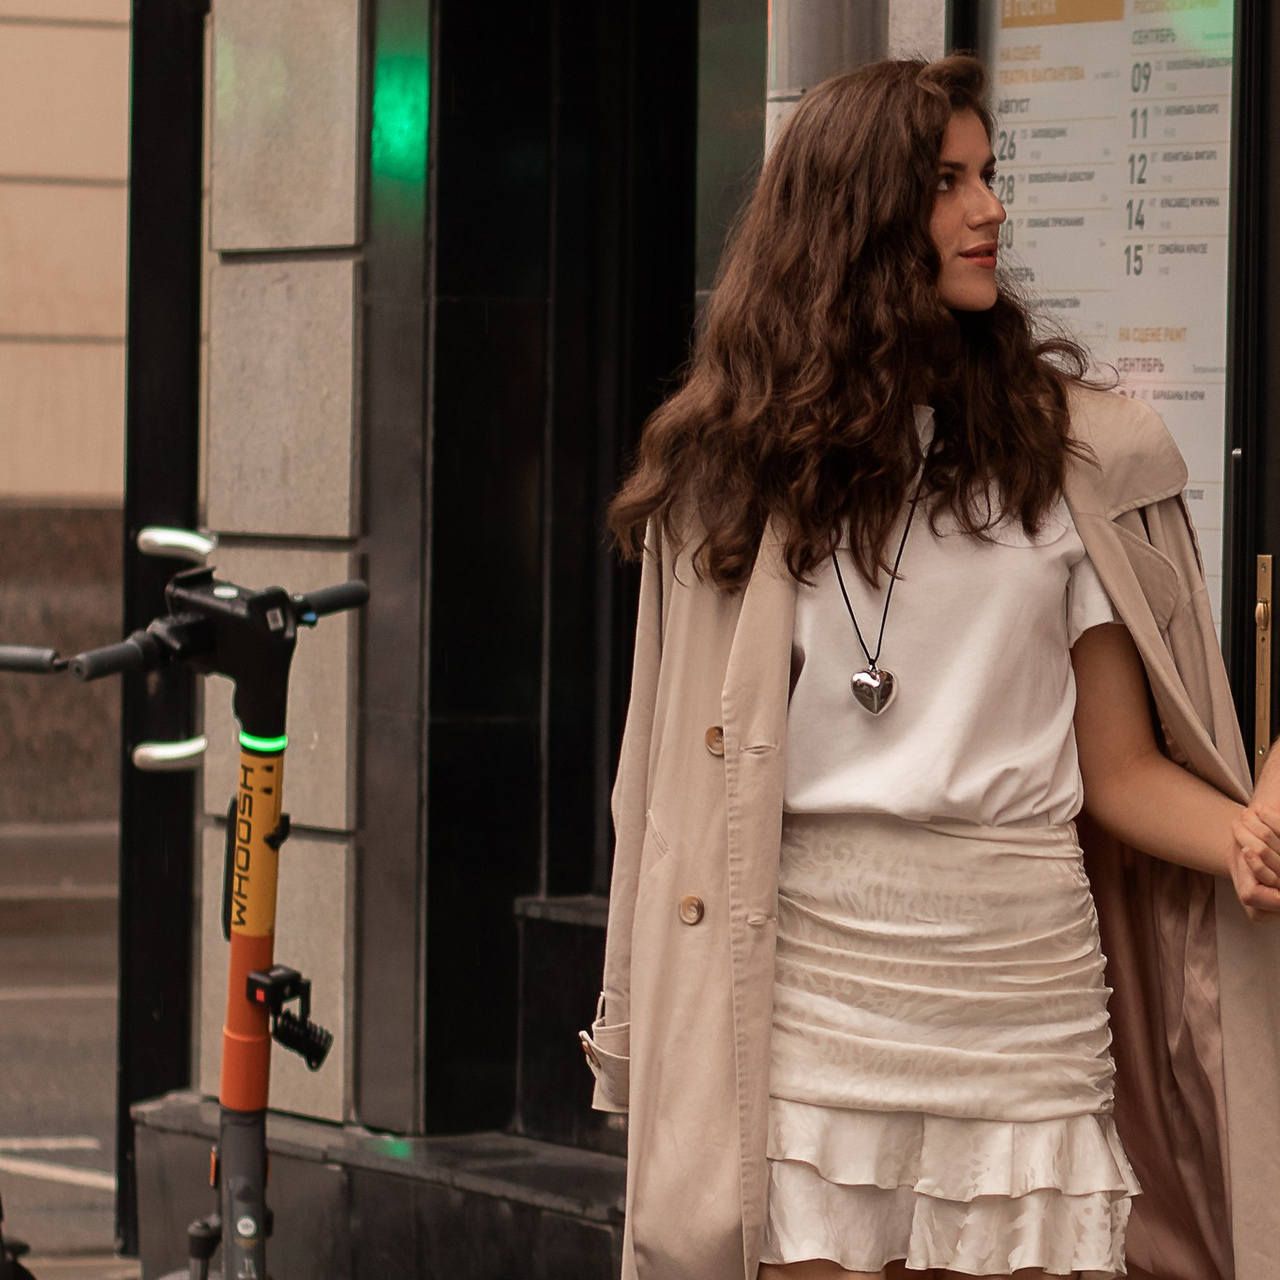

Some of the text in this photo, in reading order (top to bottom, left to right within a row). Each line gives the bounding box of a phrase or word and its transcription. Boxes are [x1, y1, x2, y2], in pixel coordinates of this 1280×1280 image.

[1133, 27, 1176, 45] СЕНТЯБРЬ
[1131, 62, 1152, 93] 09
[998, 98, 1030, 114] АВГУСТ
[1131, 107, 1148, 139] 11
[998, 130, 1016, 161] 26
[1128, 153, 1148, 184] 12
[998, 174, 1015, 205] 28
[1126, 199, 1145, 231] 14
[1124, 244, 1143, 276] 15
[1118, 327, 1131, 343] НА
[1133, 327, 1162, 343] СЦЕНЕ
[1117, 357, 1165, 373] СЕНТЯБРЬ
[232, 764, 254, 926] WHOOSH
